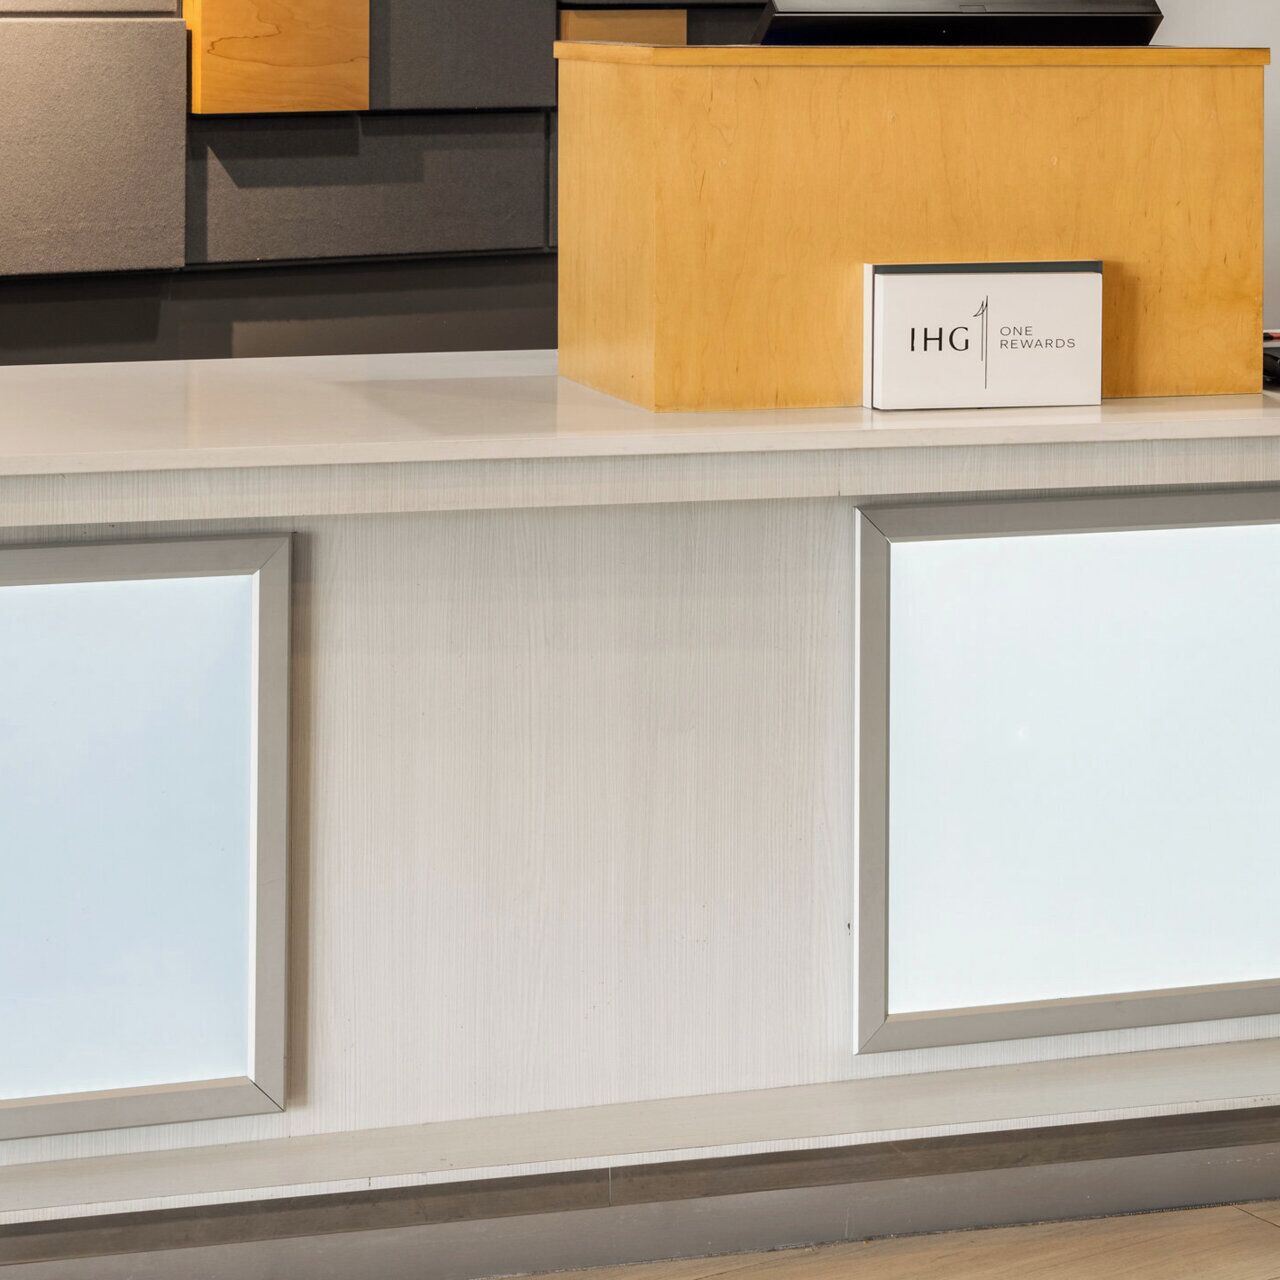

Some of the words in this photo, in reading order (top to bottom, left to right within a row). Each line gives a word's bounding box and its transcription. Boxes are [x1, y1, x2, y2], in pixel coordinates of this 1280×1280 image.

[910, 326, 969, 352] IHG
[999, 325, 1033, 337] ONE
[999, 337, 1076, 350] REWARDS
